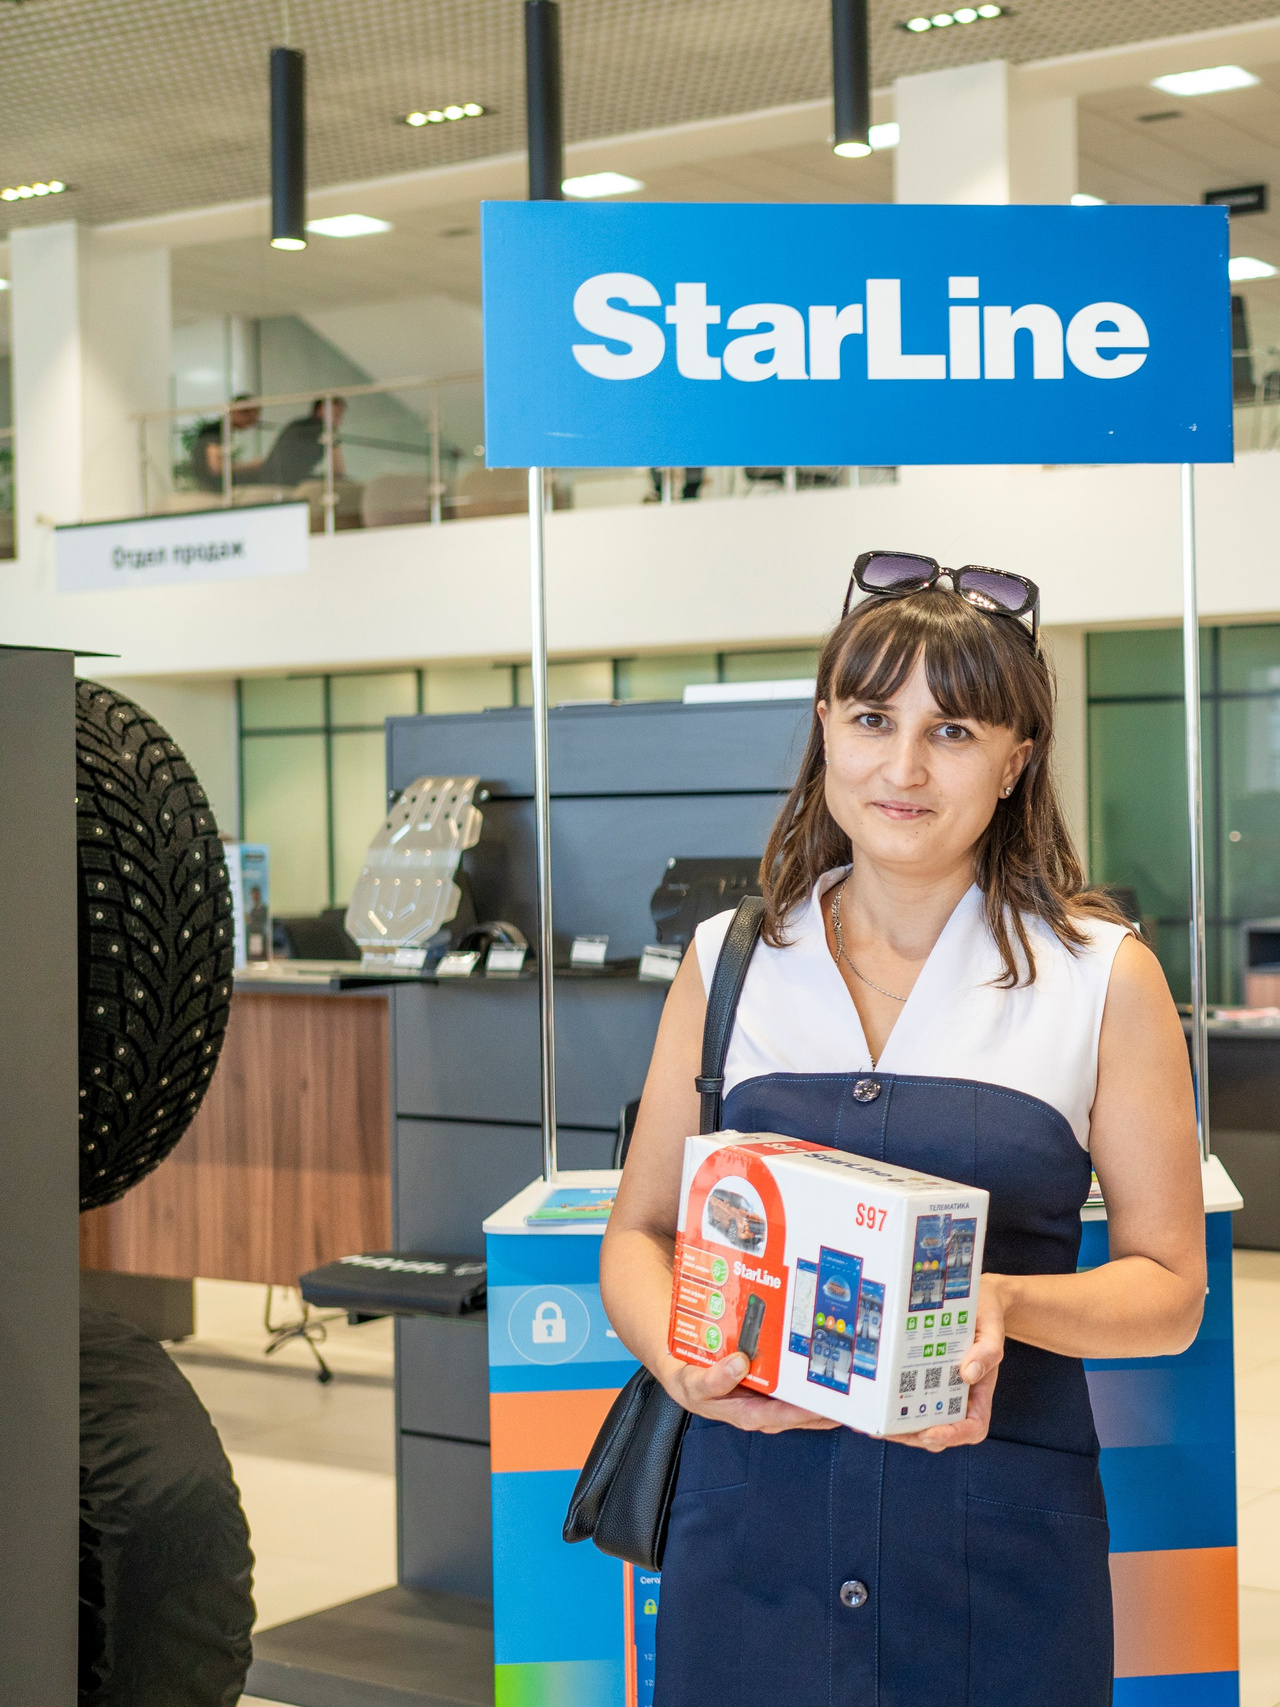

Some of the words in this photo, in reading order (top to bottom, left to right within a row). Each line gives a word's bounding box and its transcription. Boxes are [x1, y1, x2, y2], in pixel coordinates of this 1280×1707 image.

[572, 272, 1150, 382] StarLine
[112, 546, 166, 569] Отдел
[173, 540, 245, 567] продаж
[804, 1152, 893, 1177] StarLine
[855, 1202, 888, 1232] S97
[929, 1202, 970, 1211] ТЕЛЕМАТИКА
[733, 1260, 781, 1290] StarLine
